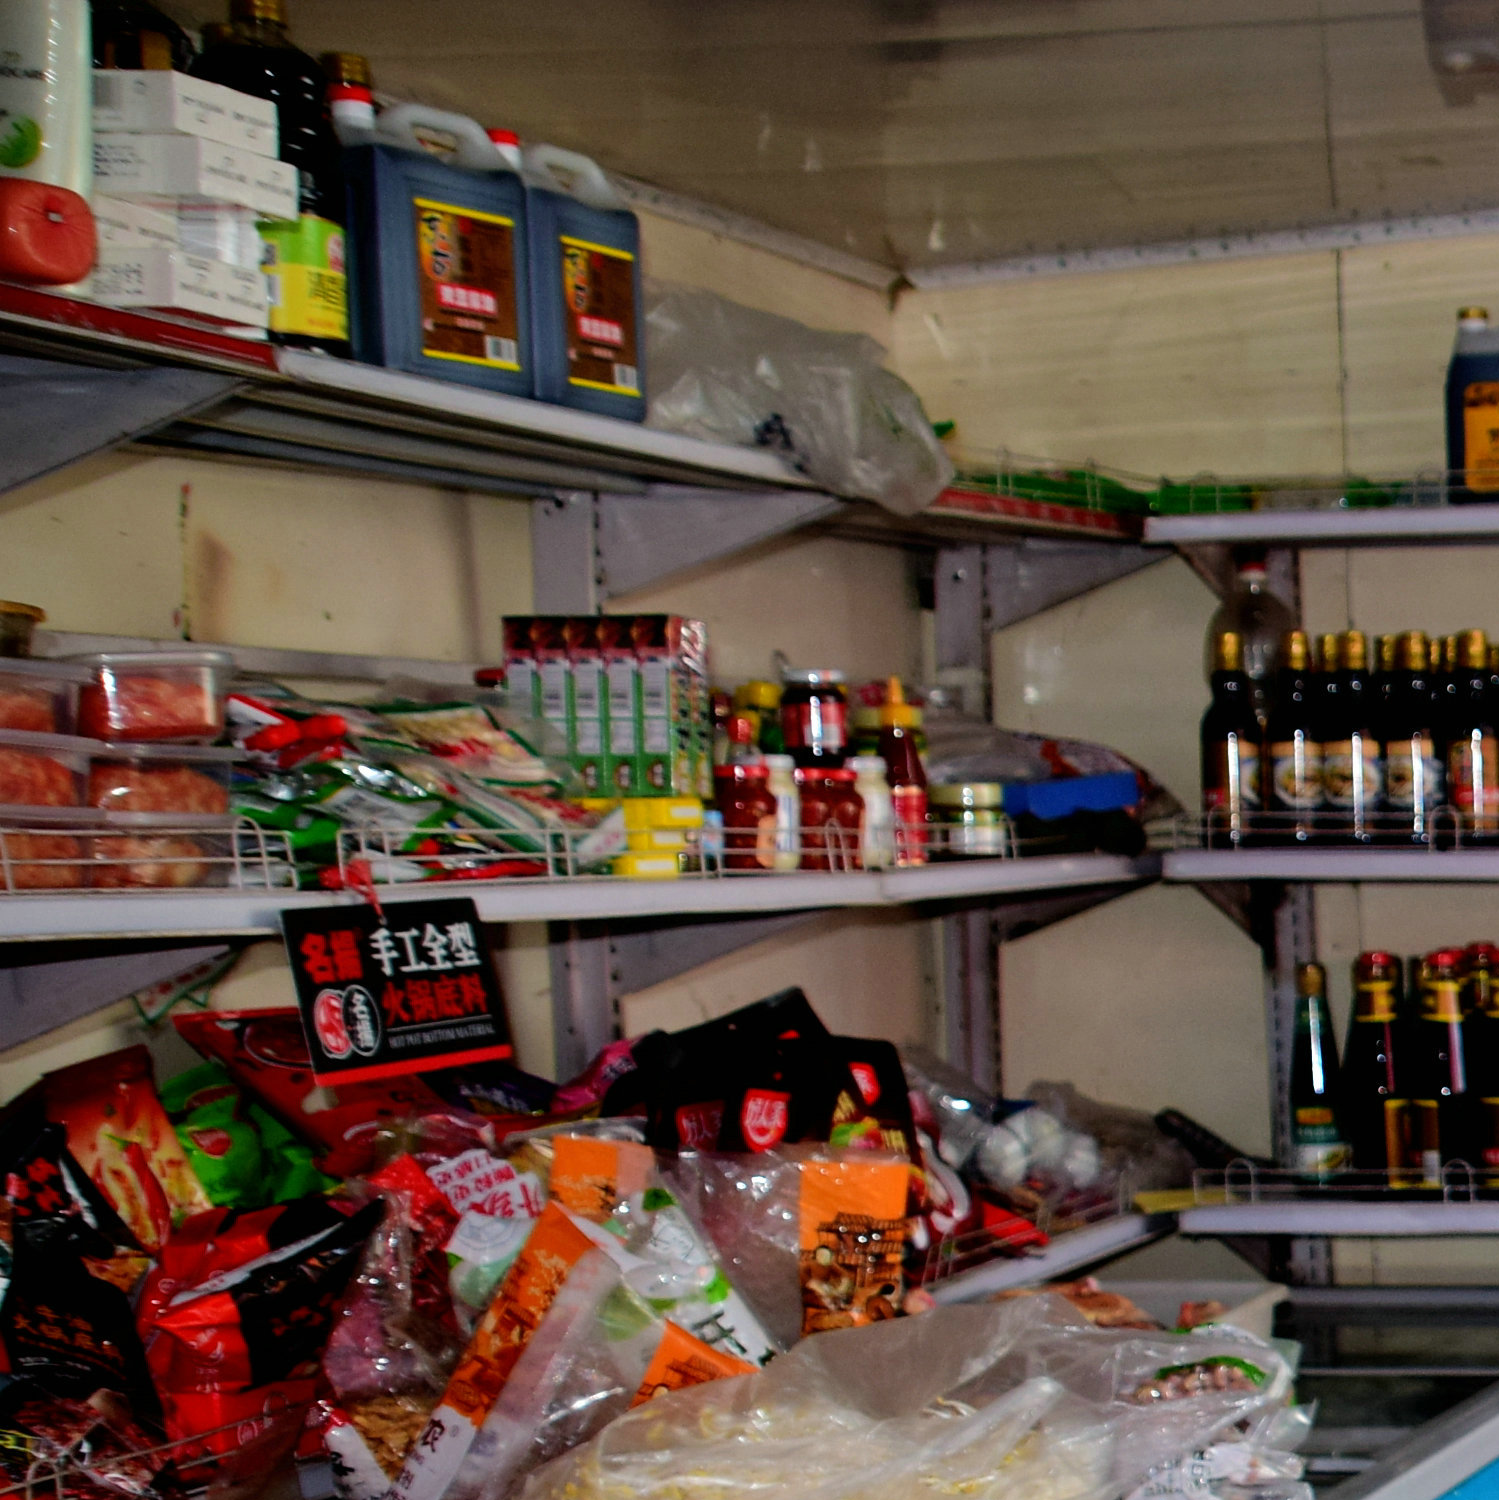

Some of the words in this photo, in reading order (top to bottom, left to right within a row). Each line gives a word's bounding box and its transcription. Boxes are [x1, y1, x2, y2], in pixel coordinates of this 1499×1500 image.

[368, 922, 482, 977] 手工全型
[381, 972, 488, 1027] 火锅底料
